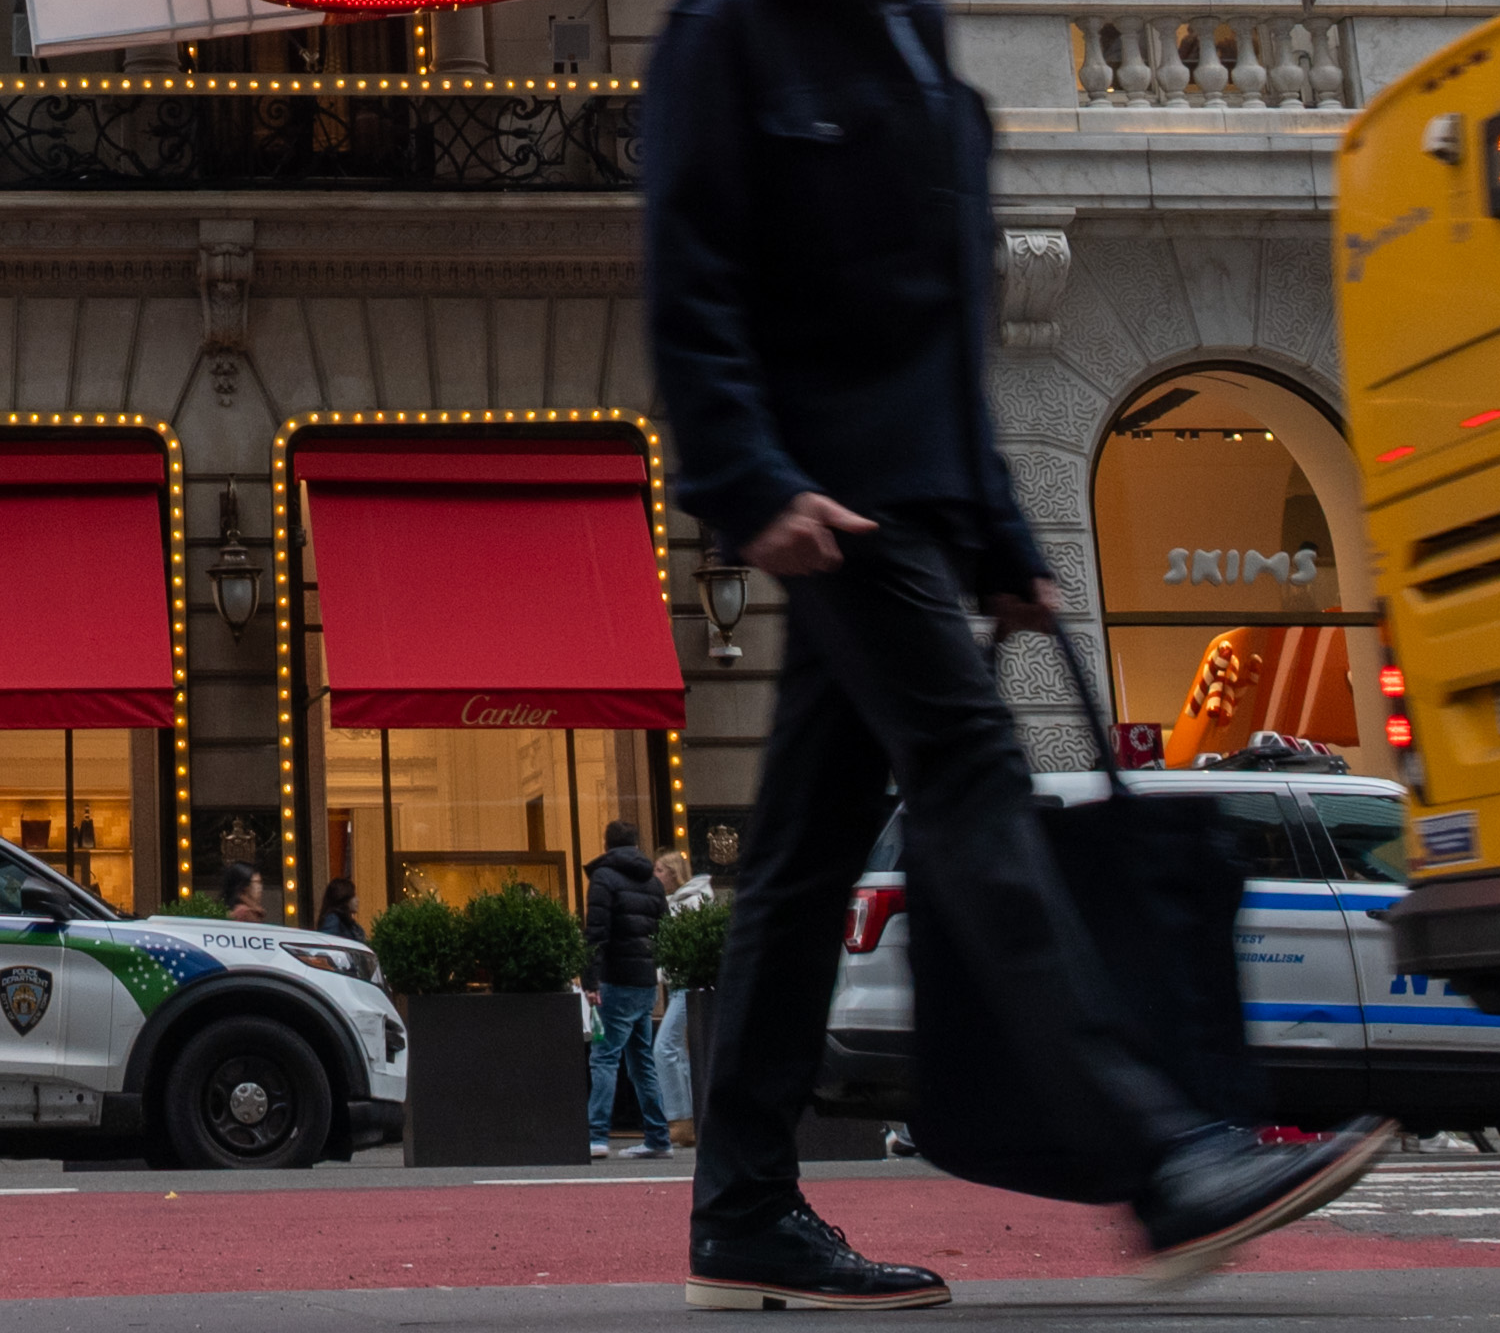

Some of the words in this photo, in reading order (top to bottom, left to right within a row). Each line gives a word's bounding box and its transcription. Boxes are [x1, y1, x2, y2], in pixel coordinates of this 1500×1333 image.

[1163, 547, 1317, 586] SKIMS
[461, 694, 558, 726] Cartier
[203, 933, 275, 951] POLICE
[1234, 935, 1265, 945] TESY
[1234, 952, 1305, 964] SIONALISM
